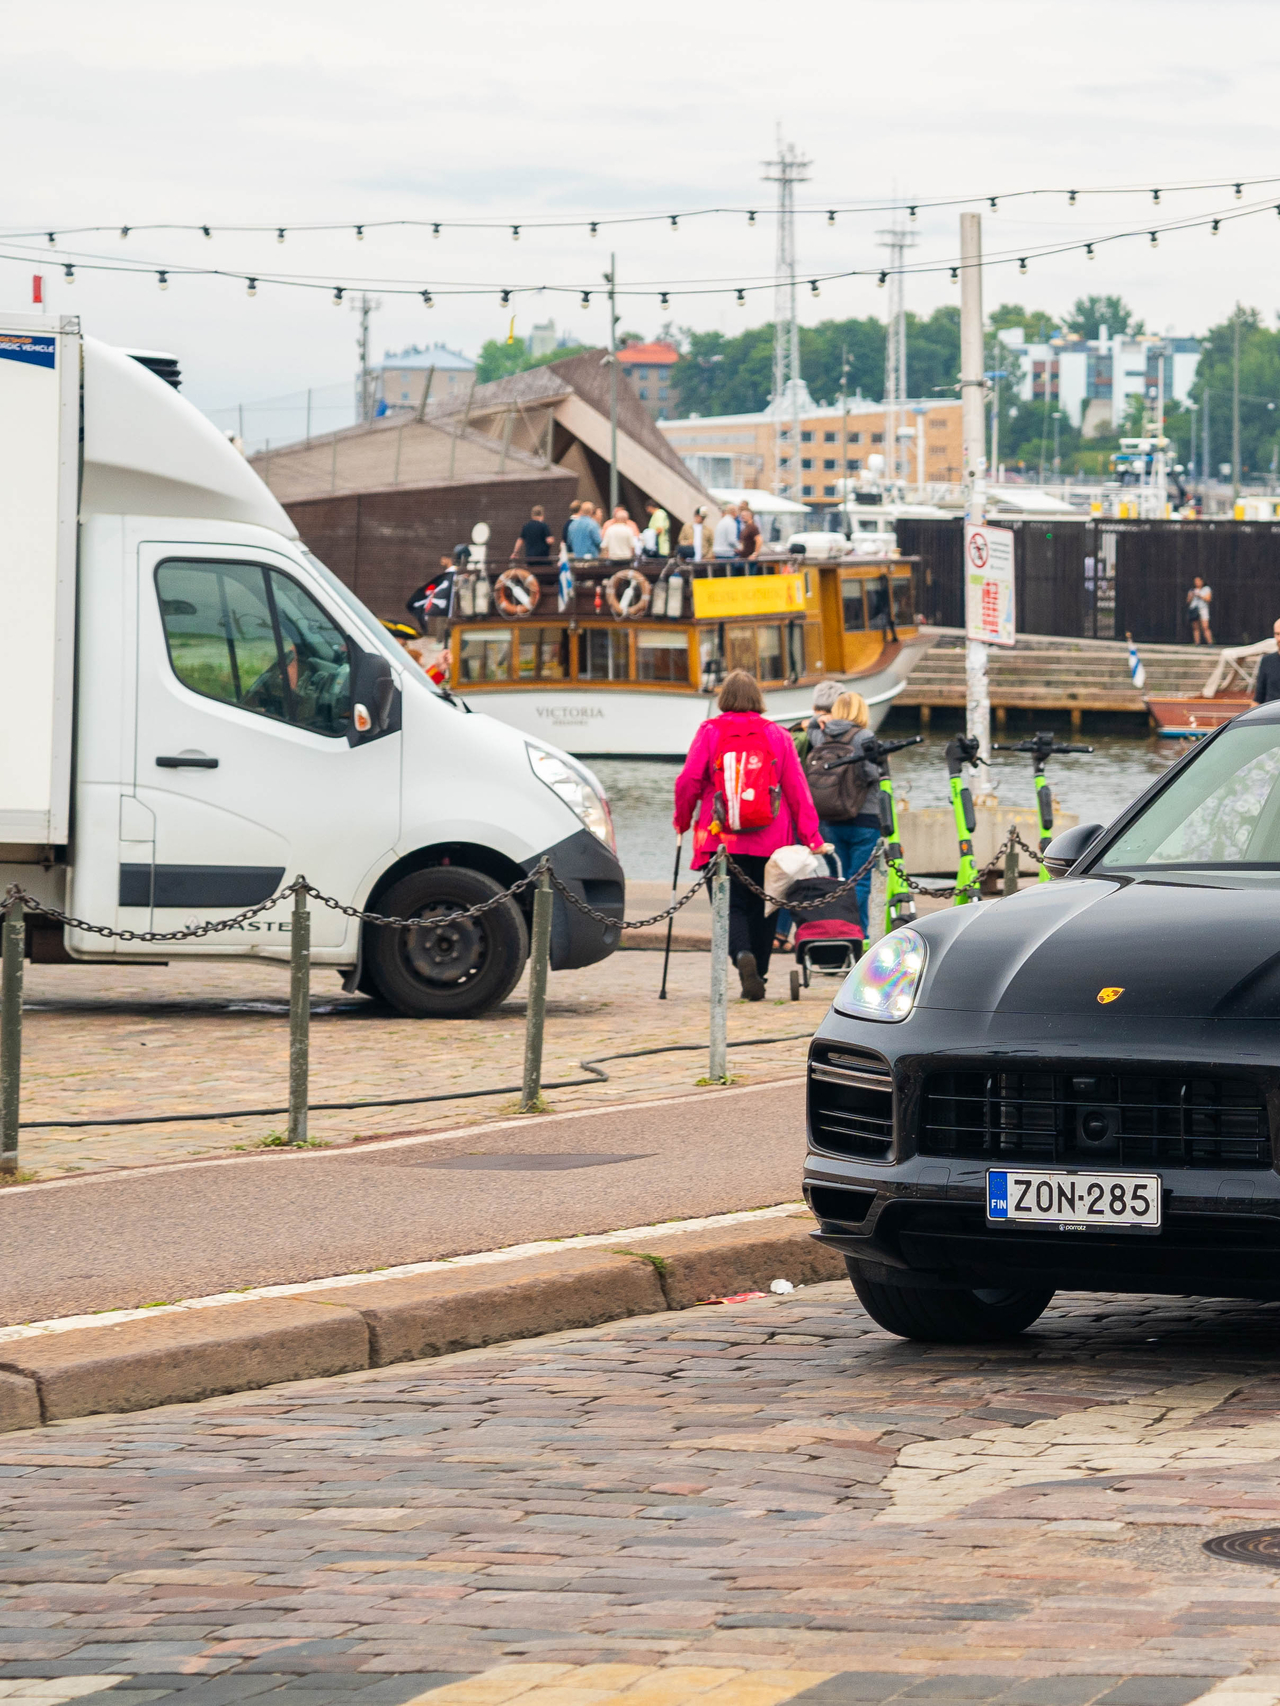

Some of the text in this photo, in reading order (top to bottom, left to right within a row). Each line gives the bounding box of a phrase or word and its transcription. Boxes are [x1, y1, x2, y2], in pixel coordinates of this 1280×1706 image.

[535, 706, 605, 719] VICTORIA
[991, 1199, 1007, 1210] FIN
[1013, 1179, 1151, 1217] ZON-285
